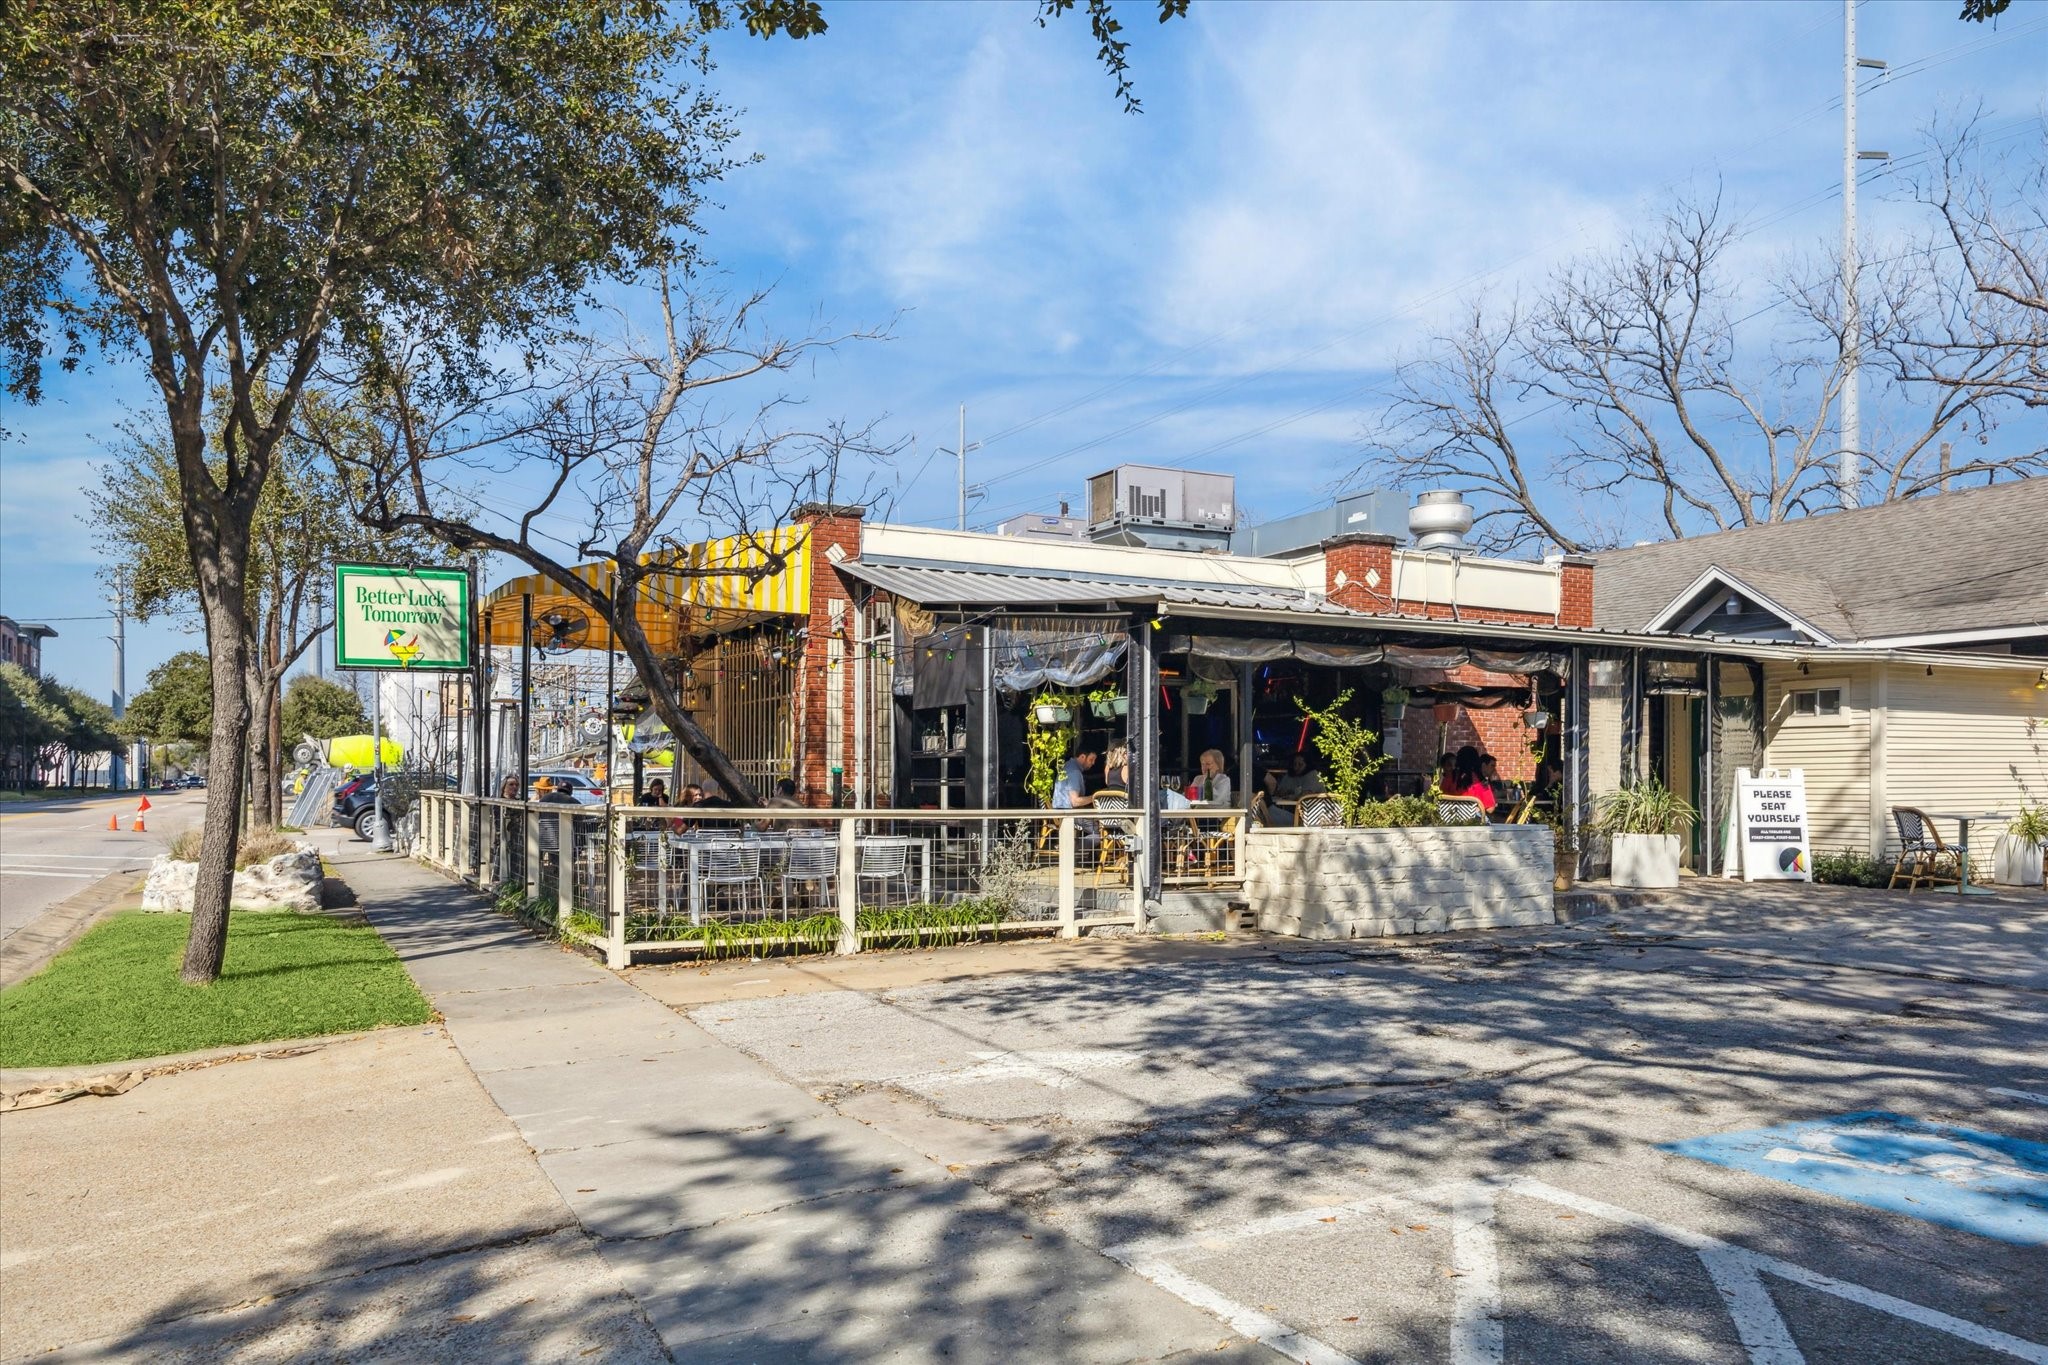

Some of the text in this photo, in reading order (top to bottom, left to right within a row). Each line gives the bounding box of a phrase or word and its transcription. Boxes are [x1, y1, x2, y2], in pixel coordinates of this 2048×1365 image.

[356, 586, 446, 607] Better Luck
[361, 605, 442, 624] Tomorrow
[1753, 790, 1792, 799] PLEASE
[1761, 802, 1786, 811] SEAT
[1748, 814, 1800, 823] YOURSELF
